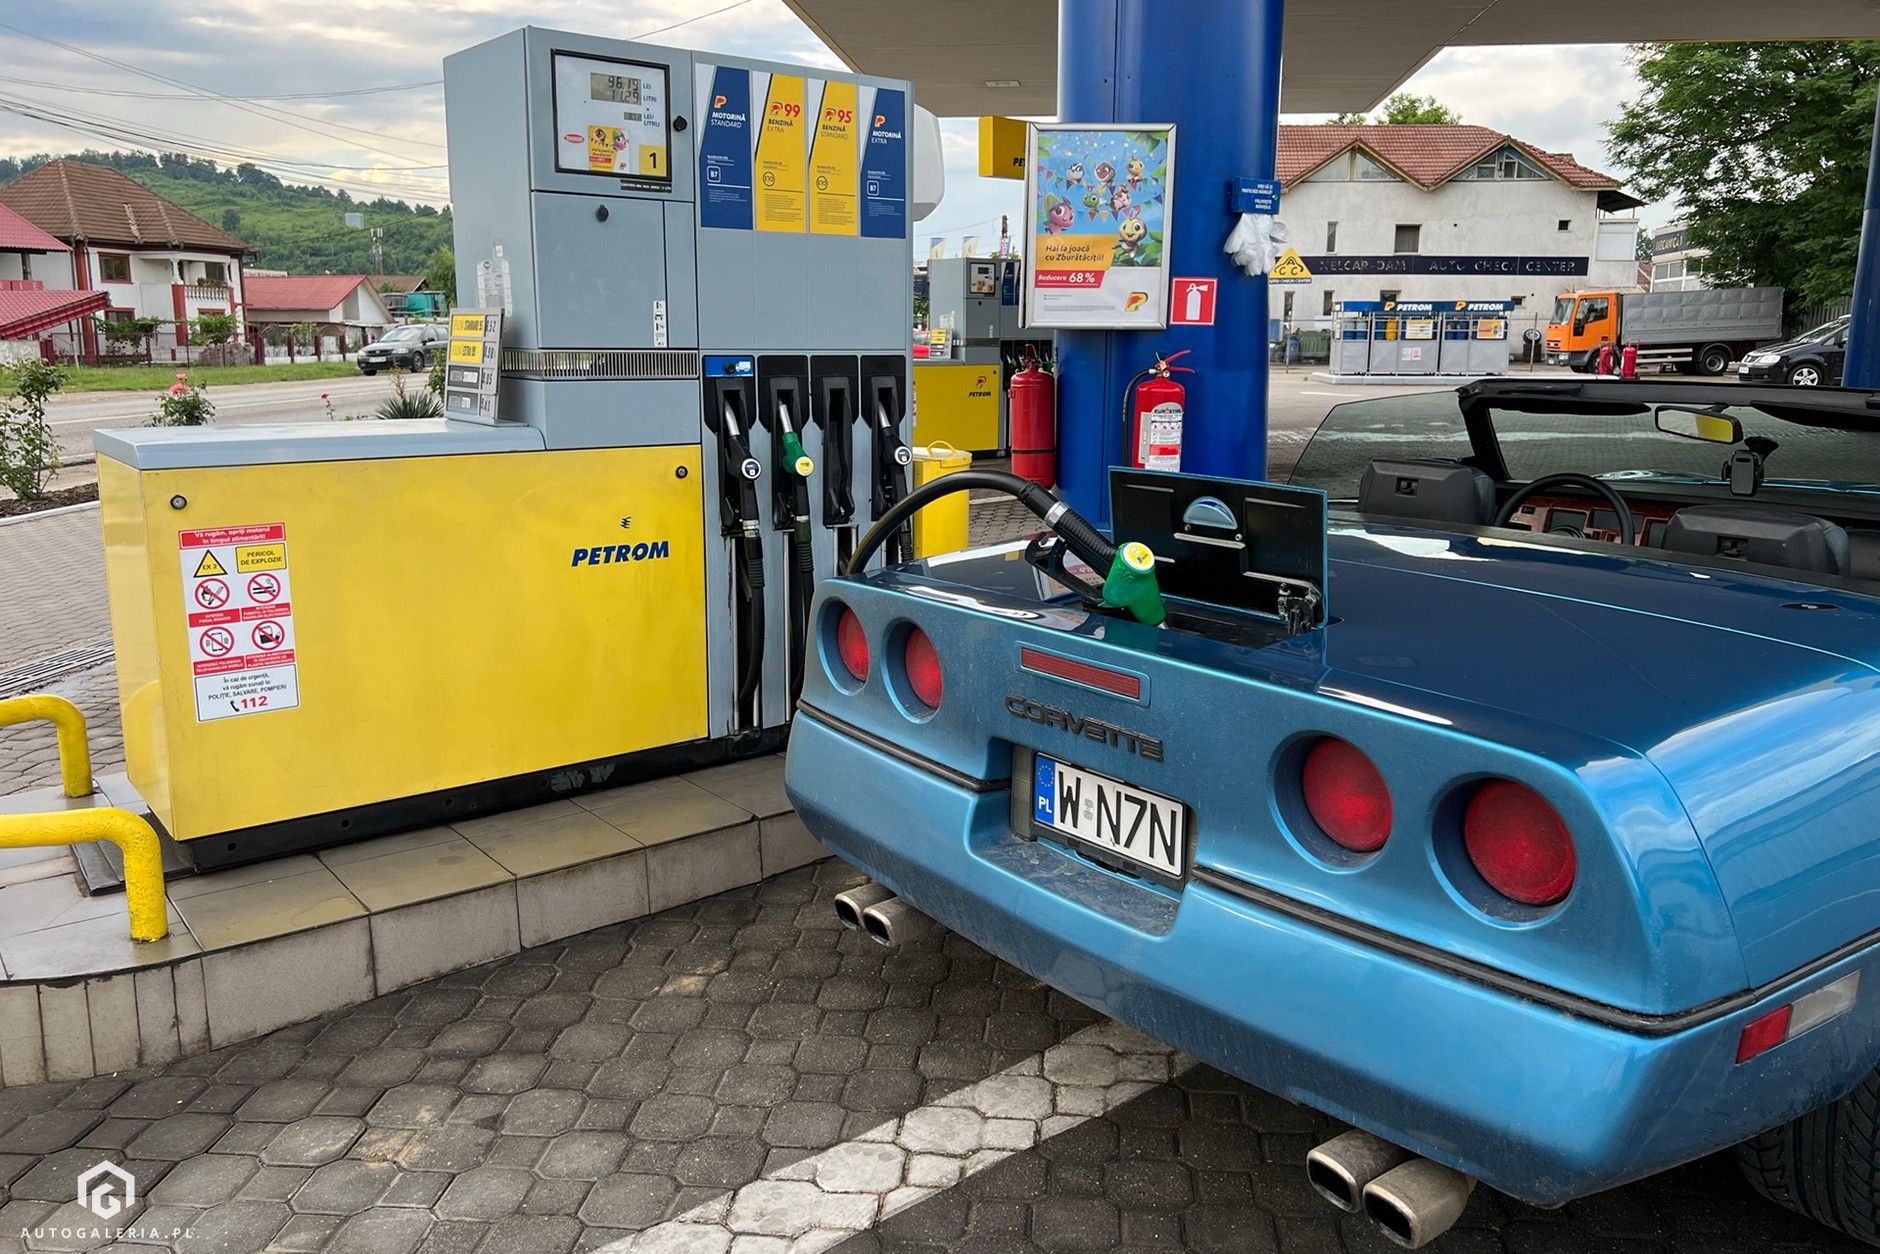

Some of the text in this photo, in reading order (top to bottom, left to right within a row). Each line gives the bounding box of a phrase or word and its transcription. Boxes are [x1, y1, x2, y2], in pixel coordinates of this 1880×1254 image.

[608, 74, 640, 91] 96.19
[643, 95, 657, 103] LITRI
[784, 103, 801, 117] 99
[712, 112, 746, 121] MOTORINĂ
[837, 109, 852, 123] 95
[710, 119, 742, 128] STANDARD
[768, 119, 793, 127] BENZINĂ
[822, 124, 846, 132] BENZINĂ
[820, 131, 848, 140] STANDARD
[872, 130, 901, 139] MOTORINĂ
[649, 152, 657, 169] 1
[1045, 244, 1059, 252] Hai
[1068, 245, 1090, 253] joacă
[1429, 260, 1466, 271] AUTO
[1474, 260, 1518, 271] CHECK
[1526, 260, 1575, 272] CENTER
[1396, 303, 1432, 311] PETROM
[1467, 303, 1503, 311] PETROM
[195, 530, 204, 538] Vă
[205, 530, 227, 538] rugăm,
[210, 536, 230, 544] timpul
[571, 540, 669, 567] PETROM
[251, 557, 282, 565] EXPLOZIE
[230, 683, 247, 691] rugăm
[233, 689, 260, 697] SALVARE,
[241, 696, 268, 709] 112
[1004, 695, 1163, 763] CORVETTE
[1038, 770, 1177, 866] PL W N7N
